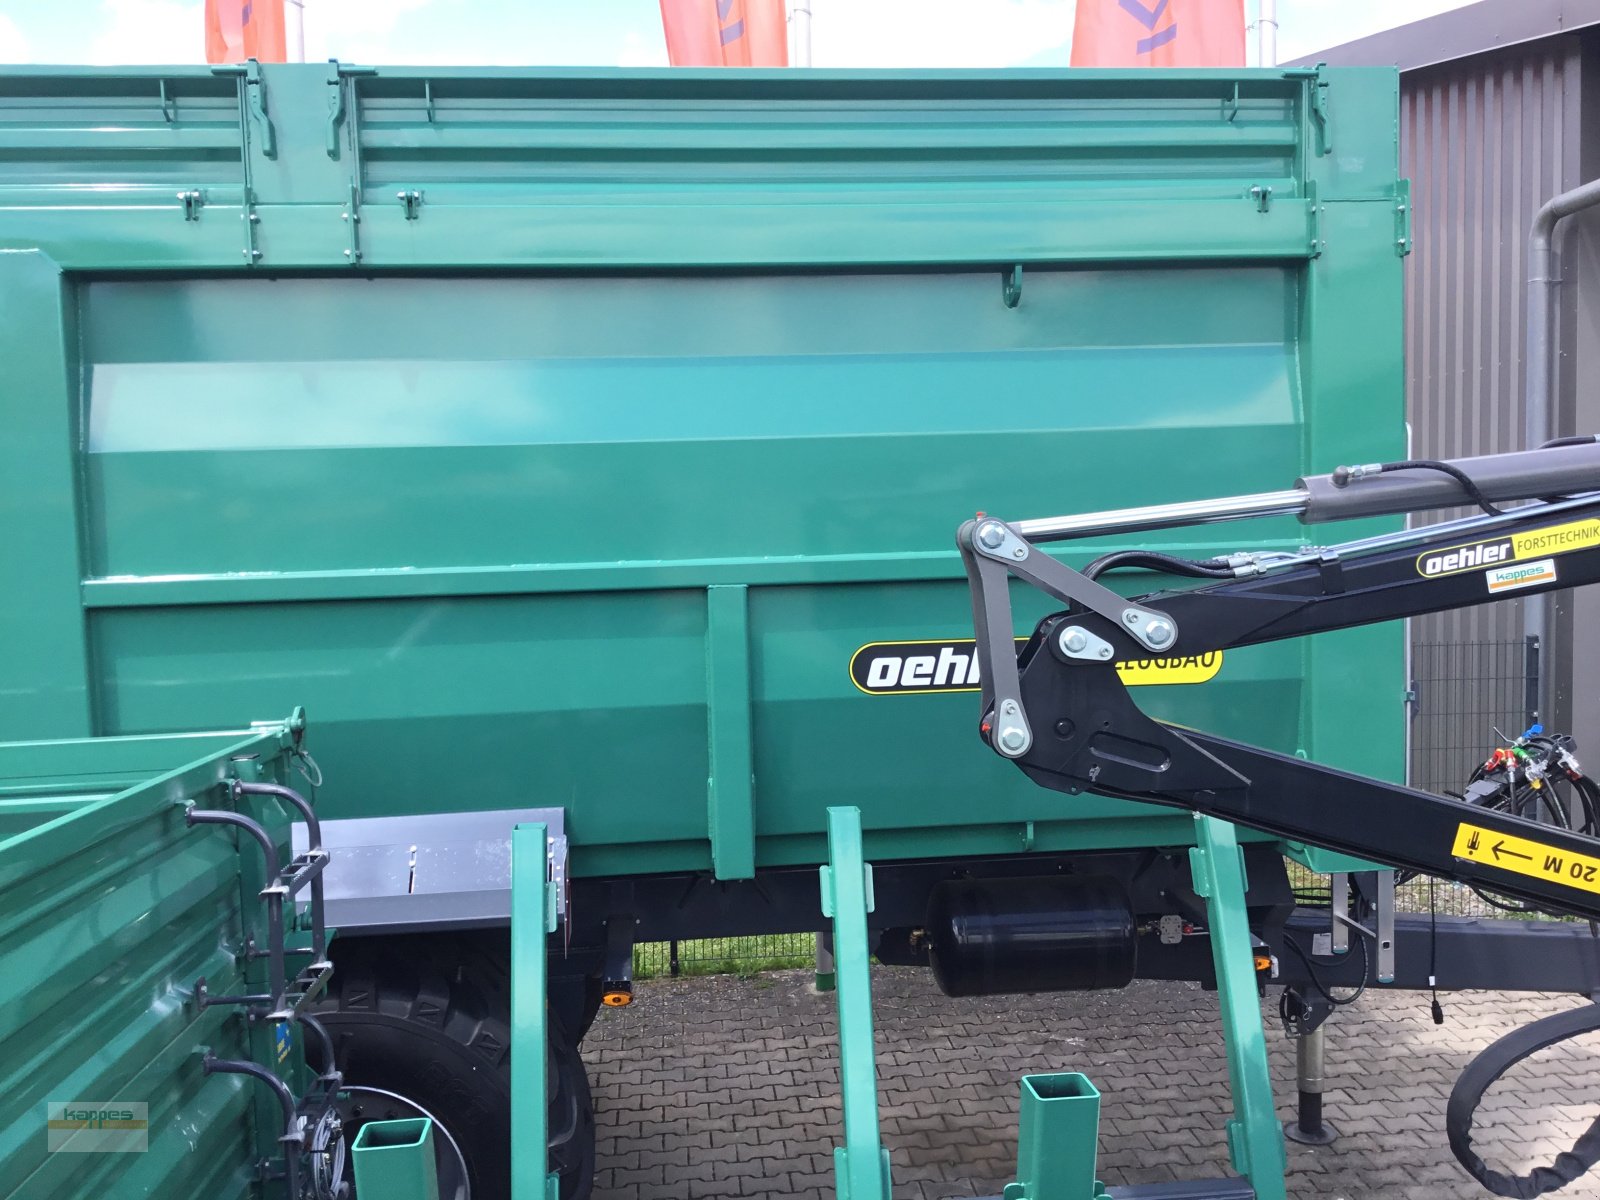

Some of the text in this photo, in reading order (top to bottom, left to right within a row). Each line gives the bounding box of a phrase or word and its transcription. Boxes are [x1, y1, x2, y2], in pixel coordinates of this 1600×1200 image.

[1425, 525, 1600, 575] oehler FORSTTECHNIK
[1496, 566, 1545, 584] kappes
[866, 646, 981, 688] oehl
[1543, 855, 1598, 883] 20 M
